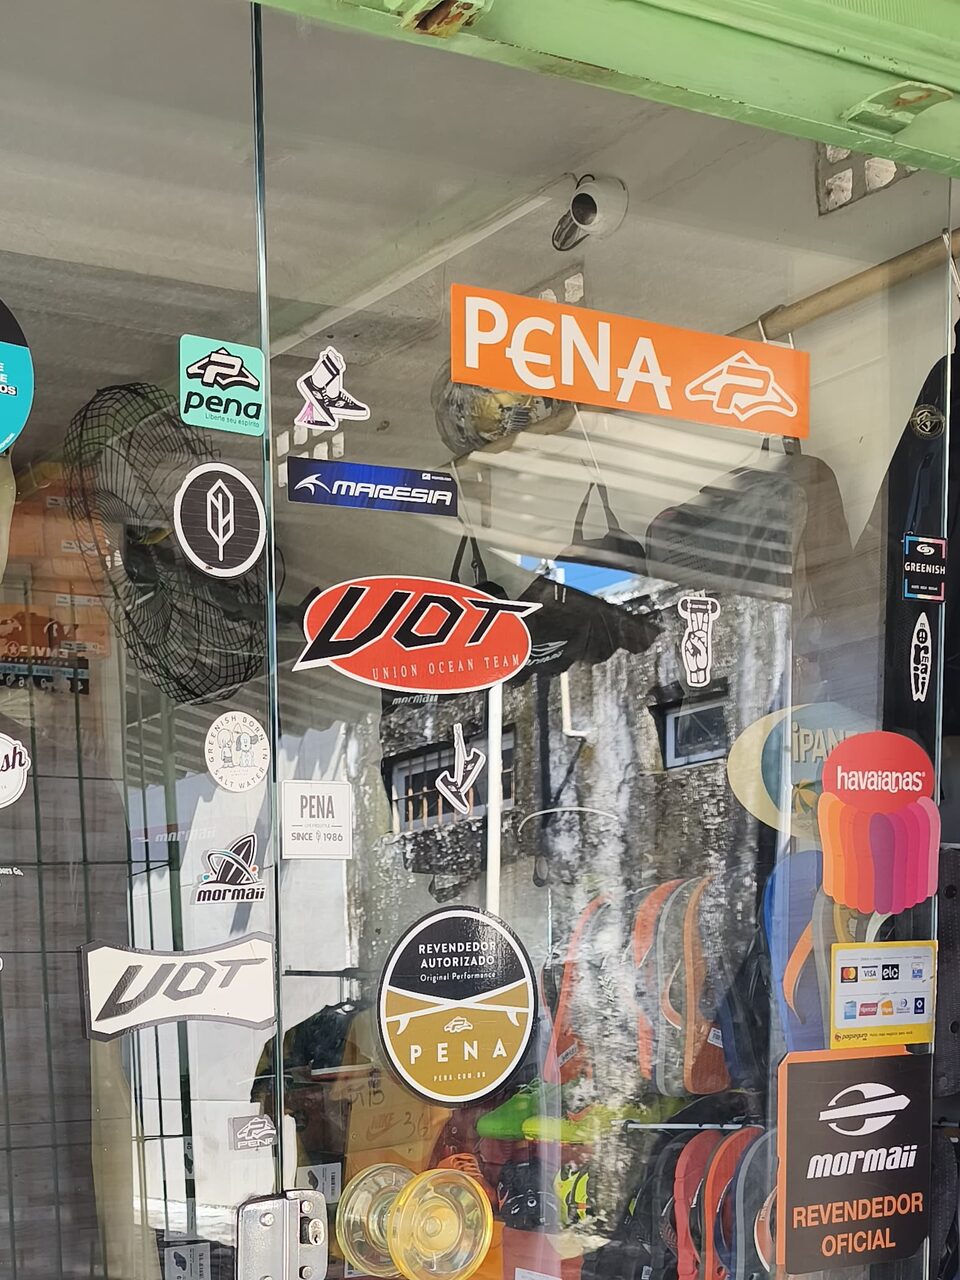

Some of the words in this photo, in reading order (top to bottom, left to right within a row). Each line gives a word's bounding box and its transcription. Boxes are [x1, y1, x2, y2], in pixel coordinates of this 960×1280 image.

[464, 294, 672, 410] PENA
[0, 373, 8, 383] E
[183, 391, 262, 420] pena
[331, 480, 453, 506] MARESIA
[904, 561, 946, 575] GREENISH
[295, 586, 540, 668] UOT
[372, 664, 419, 681] UNION
[428, 659, 475, 675] OCEAN
[484, 653, 521, 669] TEAM
[208, 714, 237, 763] GREENISH
[262, 747, 268, 761] IN
[213, 769, 234, 788] SALT
[238, 766, 265, 789] WATER
[300, 794, 335, 819] PENA
[291, 832, 313, 841] SINCE
[323, 832, 343, 842] 1986
[196, 886, 266, 902] mormaii
[418, 941, 497, 955] REVENDEDOR
[420, 955, 495, 969] AUTORIZADO
[863, 969, 877, 978] VISA
[95, 957, 268, 1022] UOT
[420, 973, 450, 984] Original
[451, 972, 496, 982] Performance
[410, 1038, 507, 1065] PENA
[806, 1144, 918, 1180] mormaii
[792, 1191, 924, 1229] REVENDEDOR
[821, 1227, 897, 1257] OFICIAL
